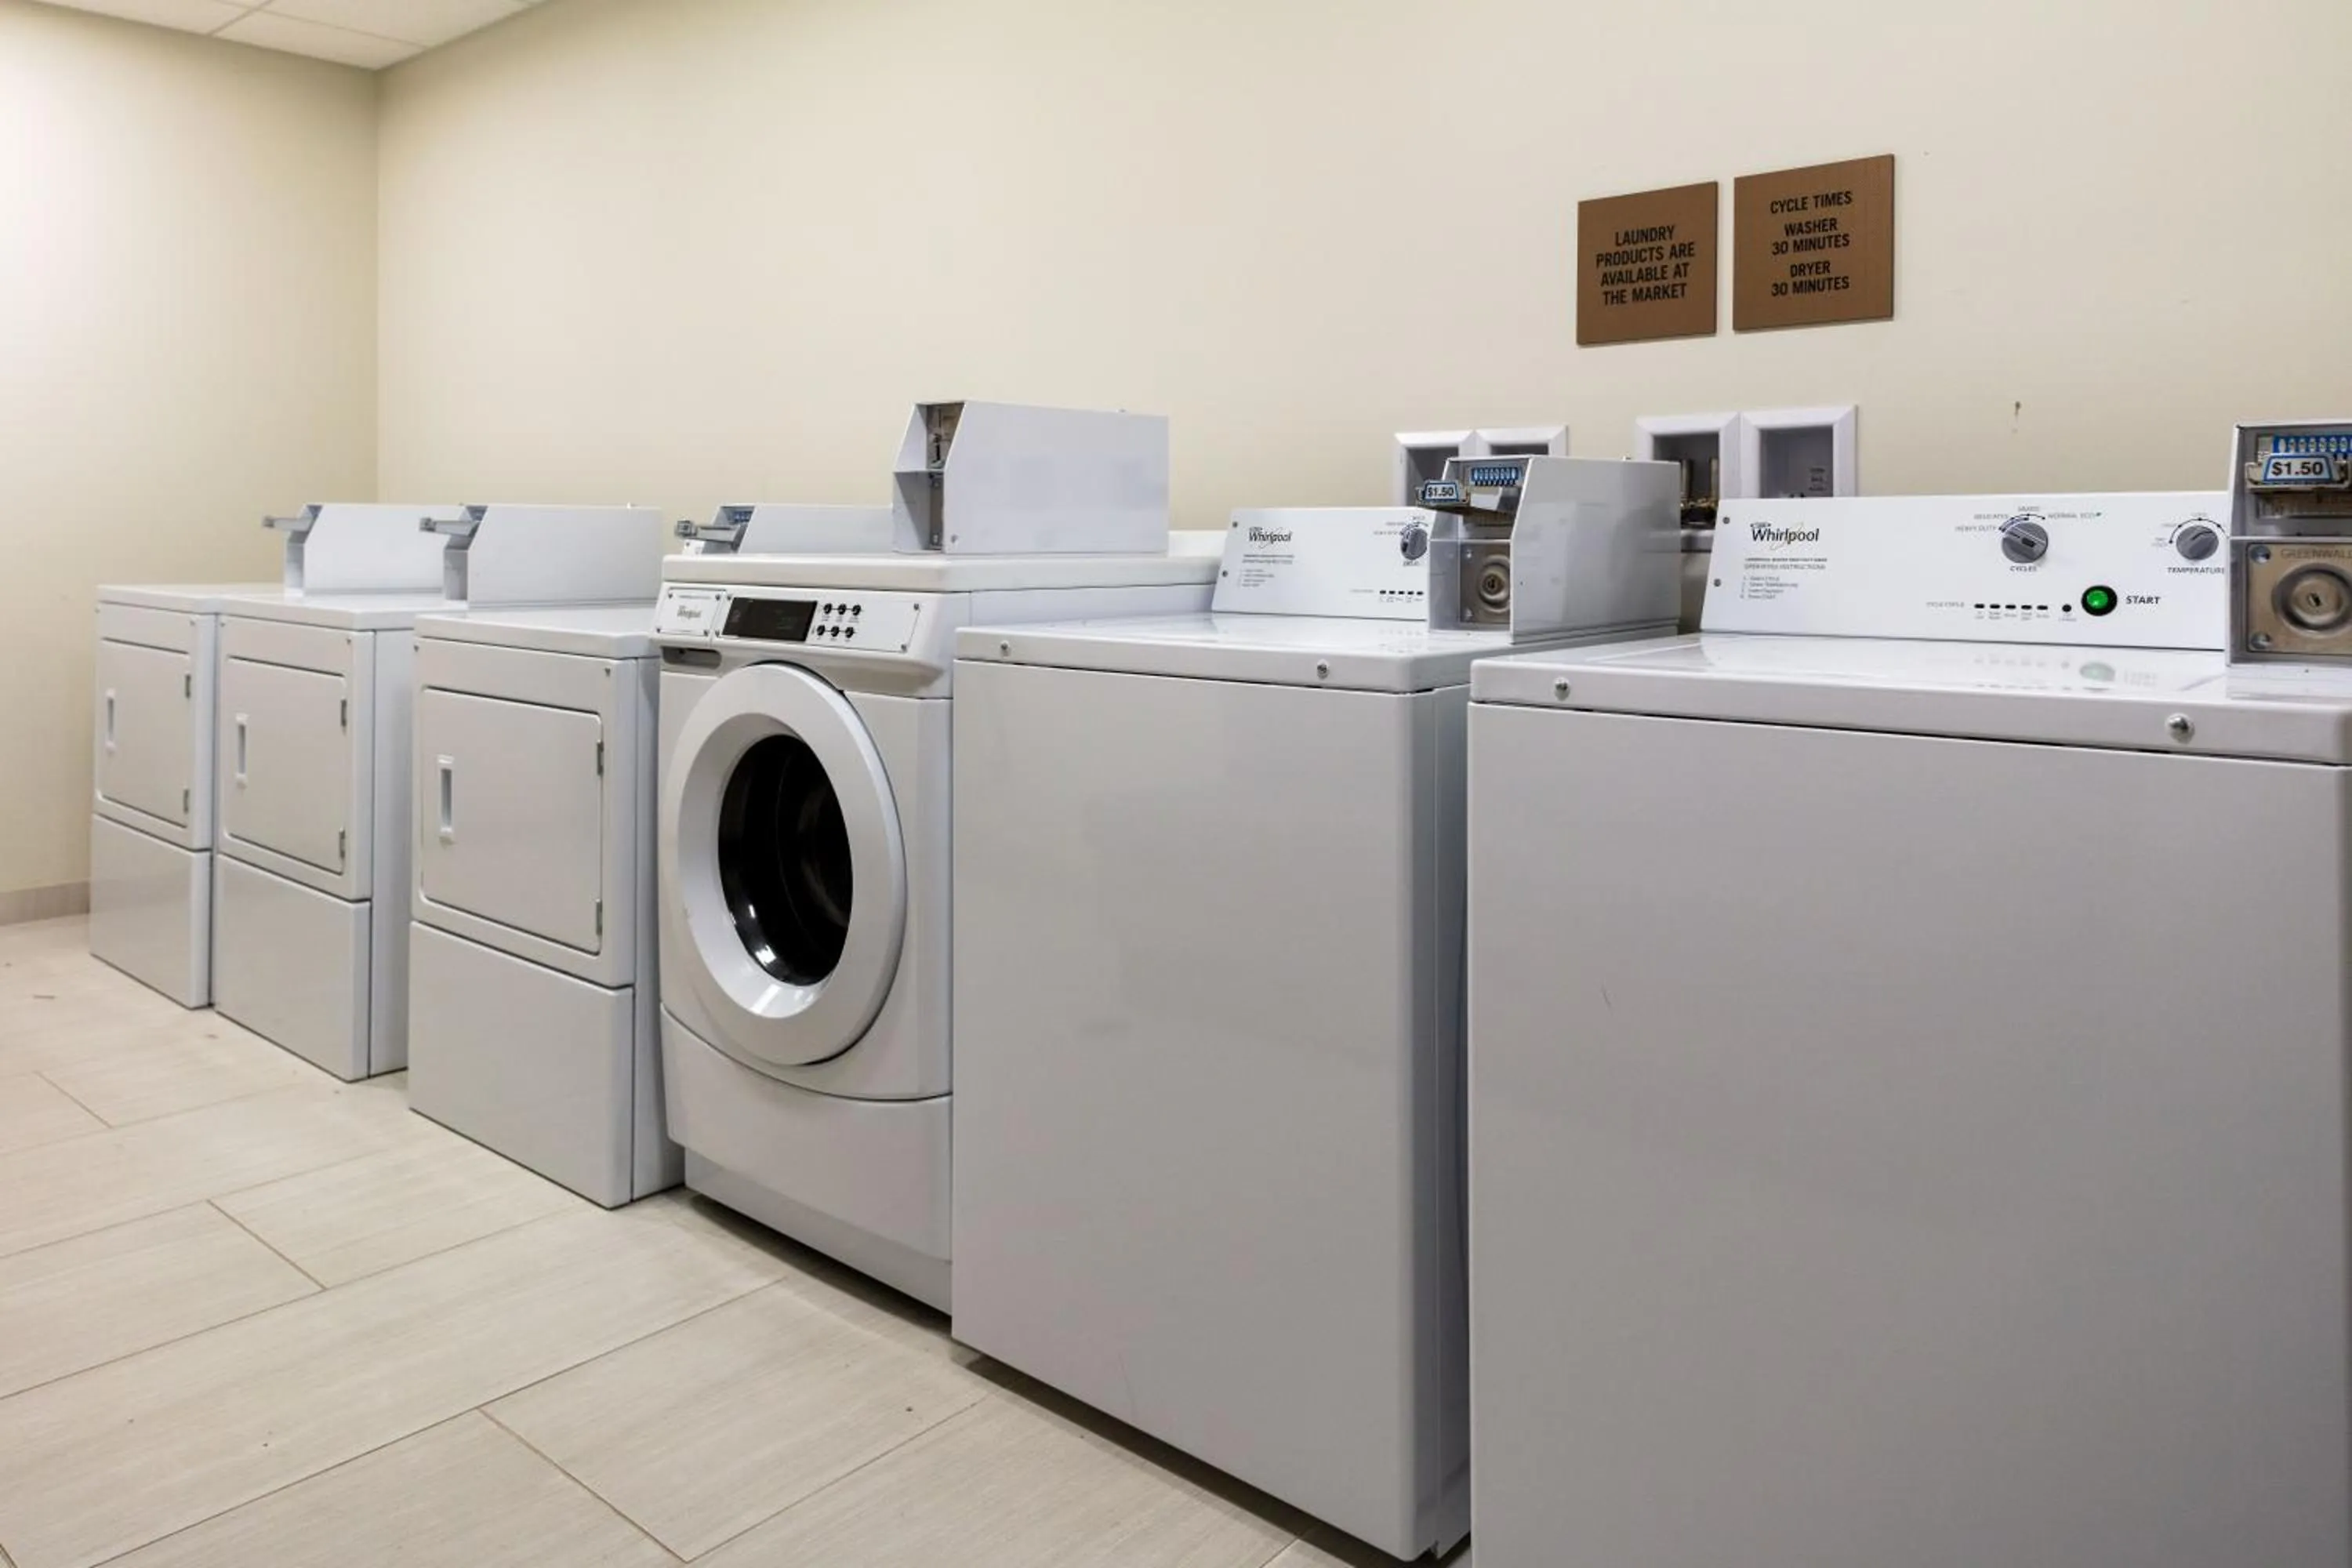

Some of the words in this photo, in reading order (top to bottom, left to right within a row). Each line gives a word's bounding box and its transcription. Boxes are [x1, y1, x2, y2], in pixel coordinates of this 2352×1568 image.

[1770, 194, 1808, 213] CYCLE
[1813, 191, 1853, 209] TIMES
[1614, 224, 1675, 247] LAUNDRY
[1784, 217, 1838, 237] WASHER
[1596, 245, 1664, 267] PRODUCTS
[1669, 241, 1695, 260] ARE
[1772, 241, 1789, 256] 30
[1793, 234, 1850, 253] MINUTES
[1600, 267, 1668, 287] AVAILABLE
[1673, 263, 1690, 280] AT
[1790, 260, 1831, 278] DRYER
[1602, 290, 1628, 306] THE
[1632, 282, 1687, 303] MARKET
[1771, 281, 1789, 297] 30
[1793, 276, 1849, 296] MINUTES
[2271, 461, 2323, 476] $1.50
[1428, 487, 1454, 497] $1.50
[1249, 531, 1293, 544] Whirlpool
[1752, 528, 1820, 544] Whirlpool
[2125, 595, 2161, 604] START
